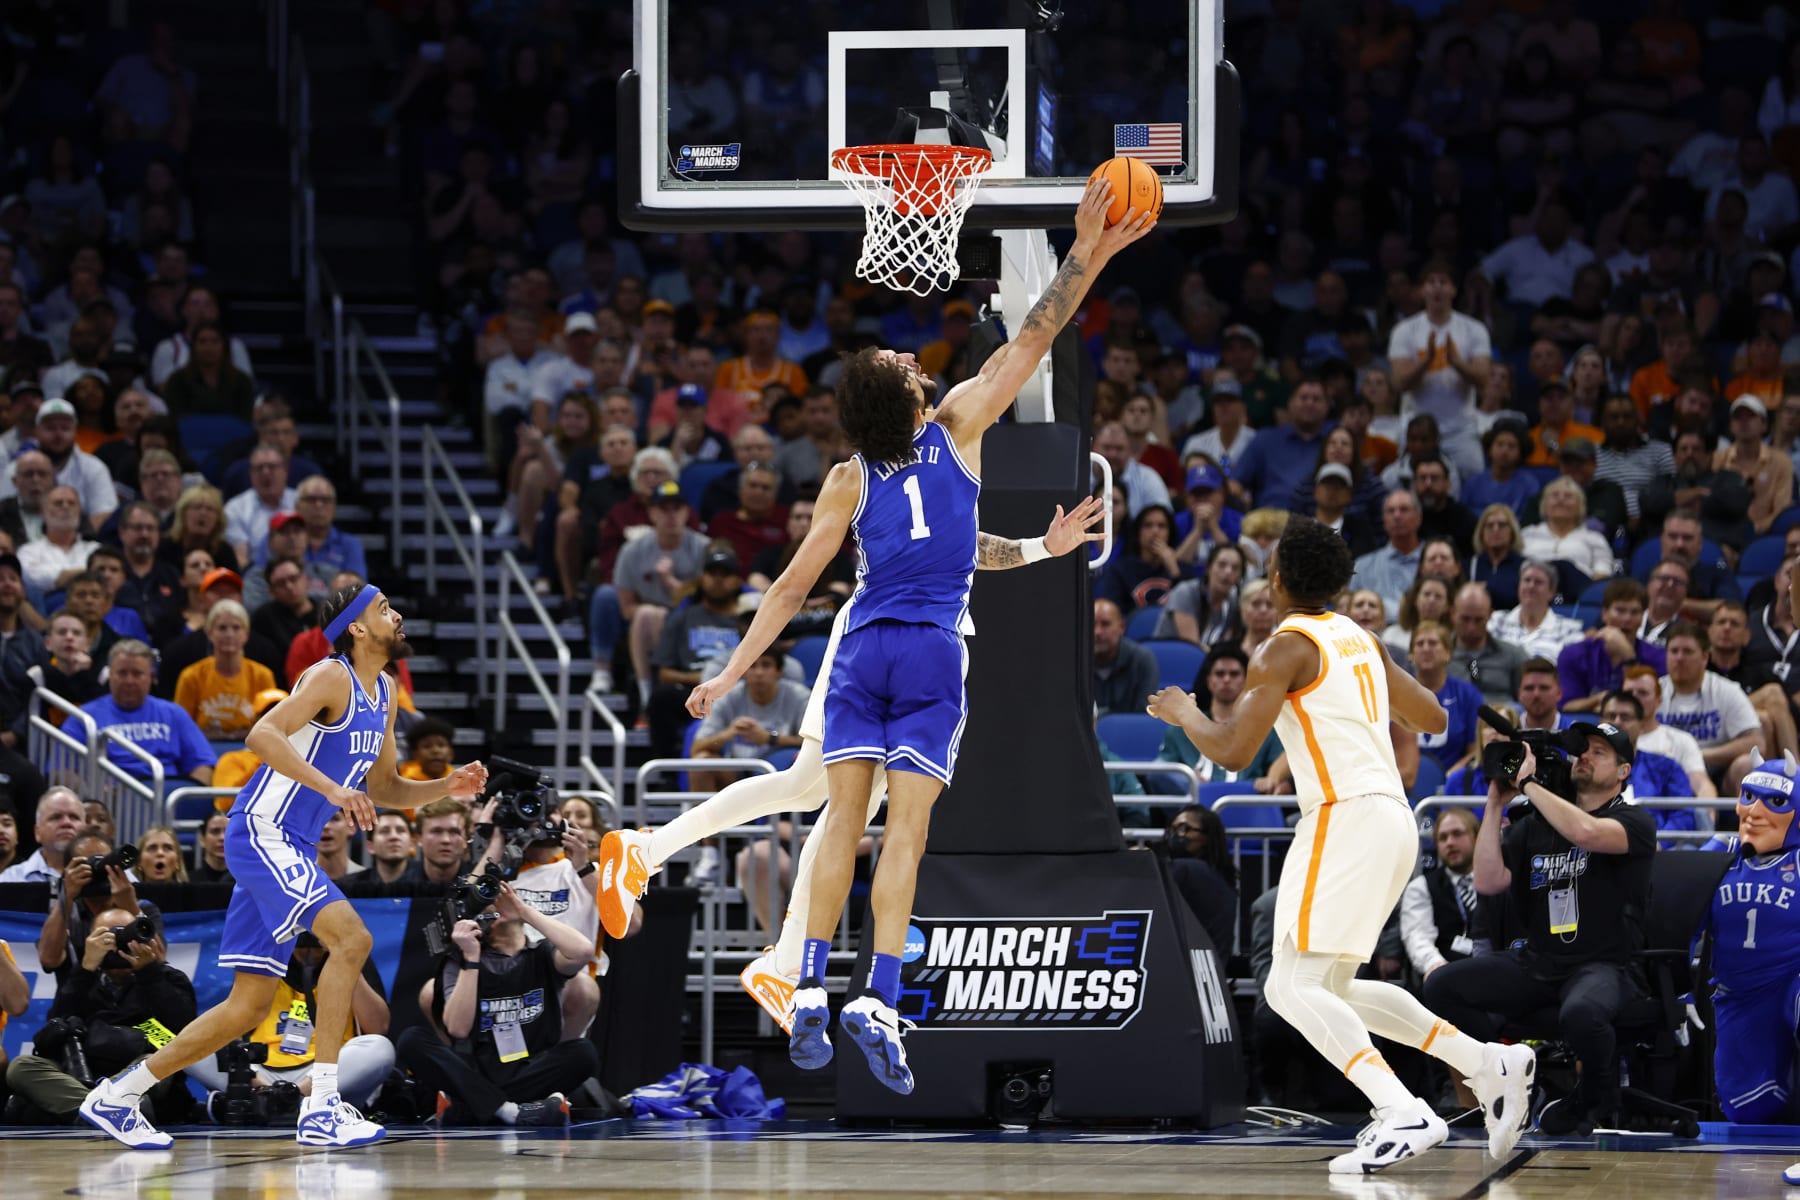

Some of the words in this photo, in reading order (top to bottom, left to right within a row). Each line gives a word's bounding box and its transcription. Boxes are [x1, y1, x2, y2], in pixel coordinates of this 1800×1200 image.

[691, 147, 723, 157] MARCH
[695, 156, 738, 167] MADNESS
[903, 475, 930, 540] 1
[1353, 663, 1378, 724] 11
[349, 730, 384, 757] DUK
[1719, 882, 1796, 910] DUKE
[903, 942, 925, 953] CAA
[926, 927, 1072, 967] MARCH
[1743, 908, 1757, 949] 1
[943, 969, 1138, 1010] MADNESS
